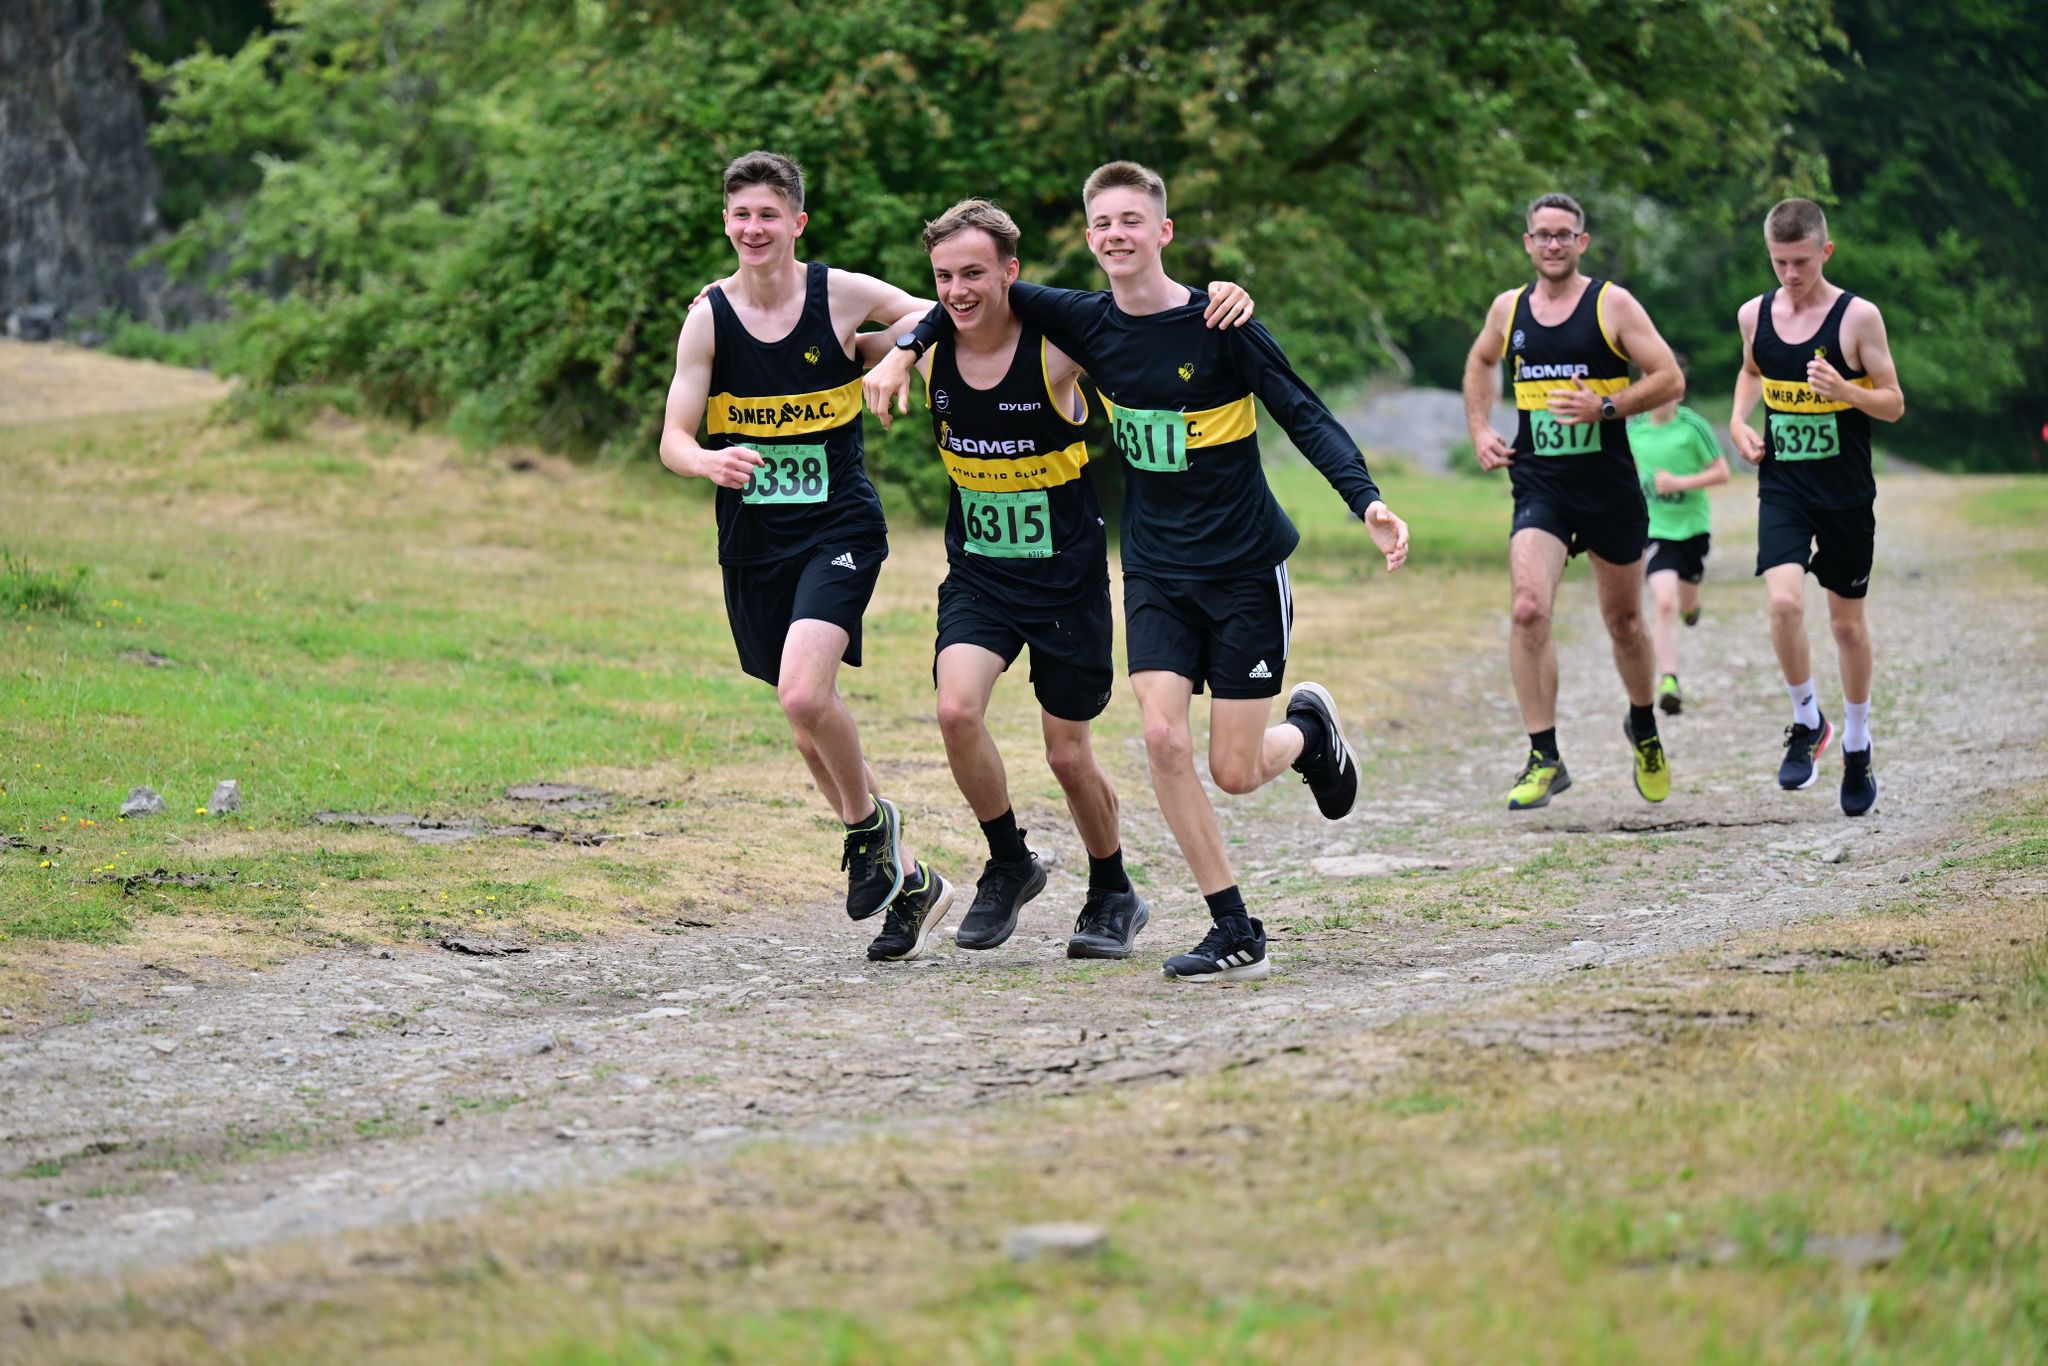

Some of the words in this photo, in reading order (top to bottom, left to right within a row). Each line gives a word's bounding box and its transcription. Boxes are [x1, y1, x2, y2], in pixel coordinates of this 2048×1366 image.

[1521, 364, 1589, 379] SOMER
[804, 402, 835, 421] A.C.
[1116, 419, 1176, 465] 6311
[1536, 420, 1596, 449] 6317
[1774, 424, 1834, 454] 6325
[949, 436, 1036, 455] SOMER
[952, 466, 1008, 480] ATHLETIC
[1015, 467, 1048, 479] CLUB
[967, 502, 1045, 544] 6315
[1028, 550, 1044, 558] 6315
[831, 559, 857, 571] adidas
